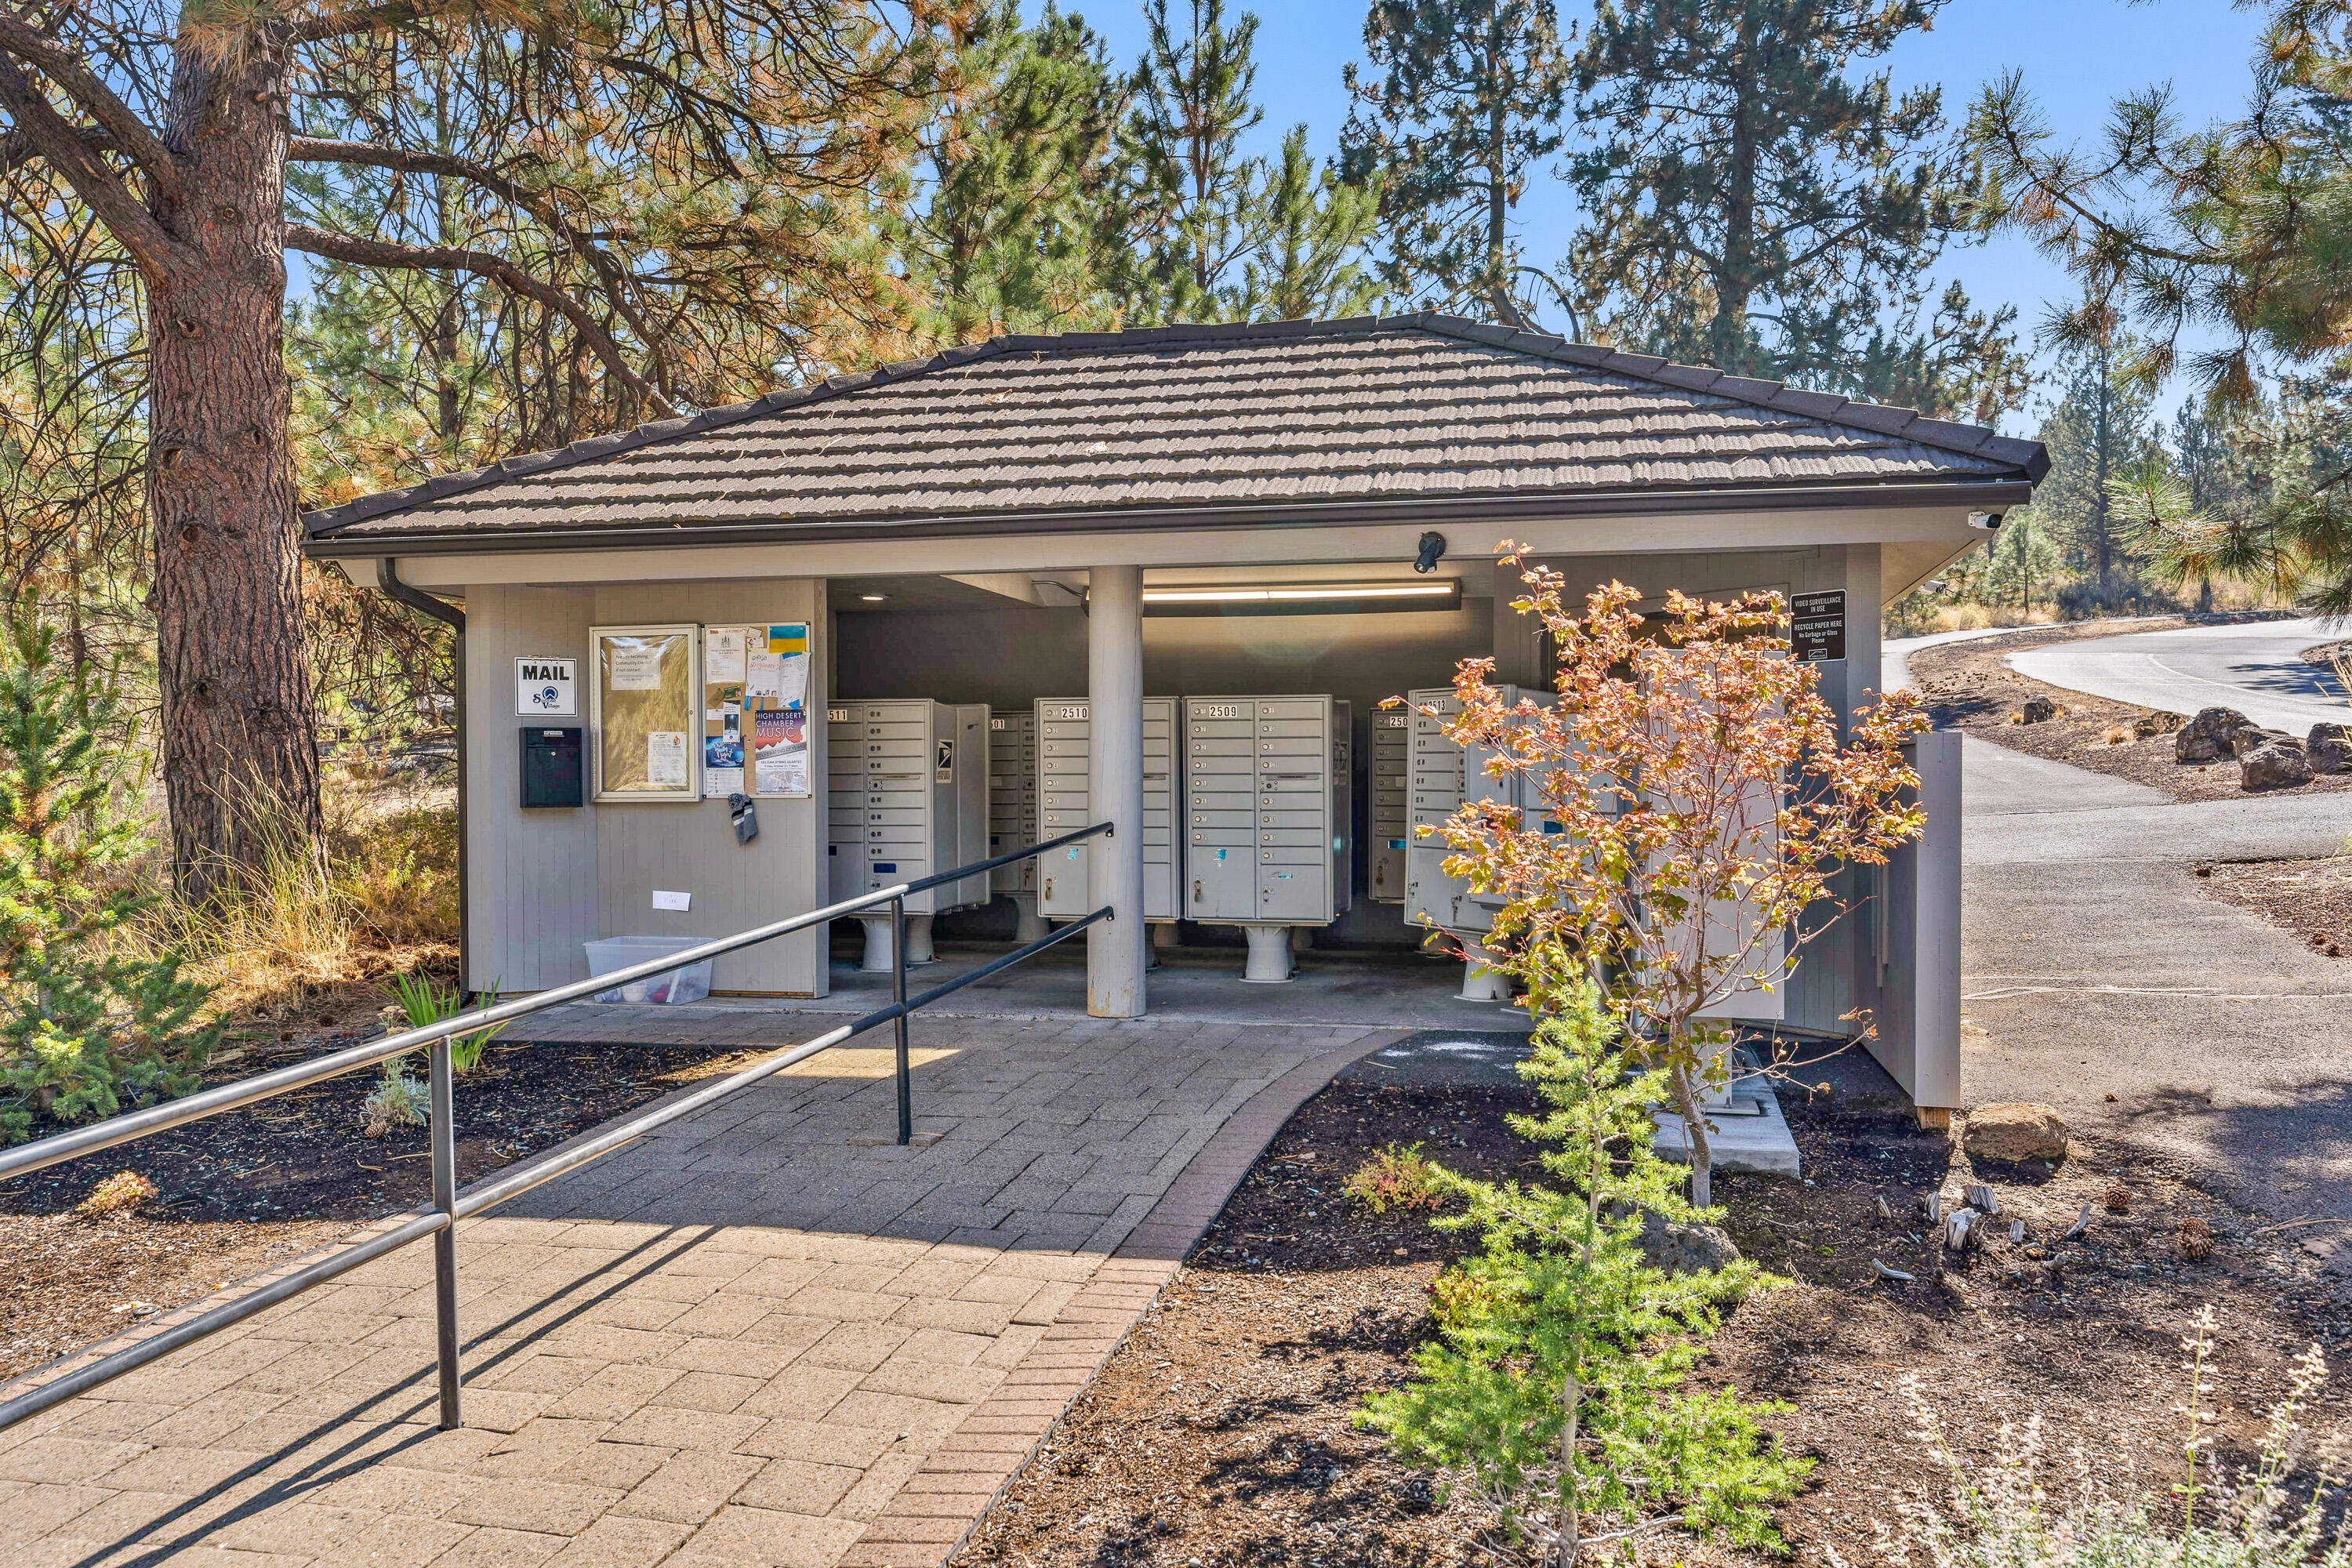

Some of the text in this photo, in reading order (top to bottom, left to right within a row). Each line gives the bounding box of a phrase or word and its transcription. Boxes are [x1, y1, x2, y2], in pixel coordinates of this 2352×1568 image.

[1809, 597, 1842, 606] SURVEILLANCE
[1795, 622, 1813, 631] RECYCLE
[523, 666, 569, 681] MAIL
[829, 710, 847, 720] 511
[1062, 708, 1087, 718] 2510
[1210, 706, 1236, 717] 2509
[757, 728, 795, 738] MUSIC
